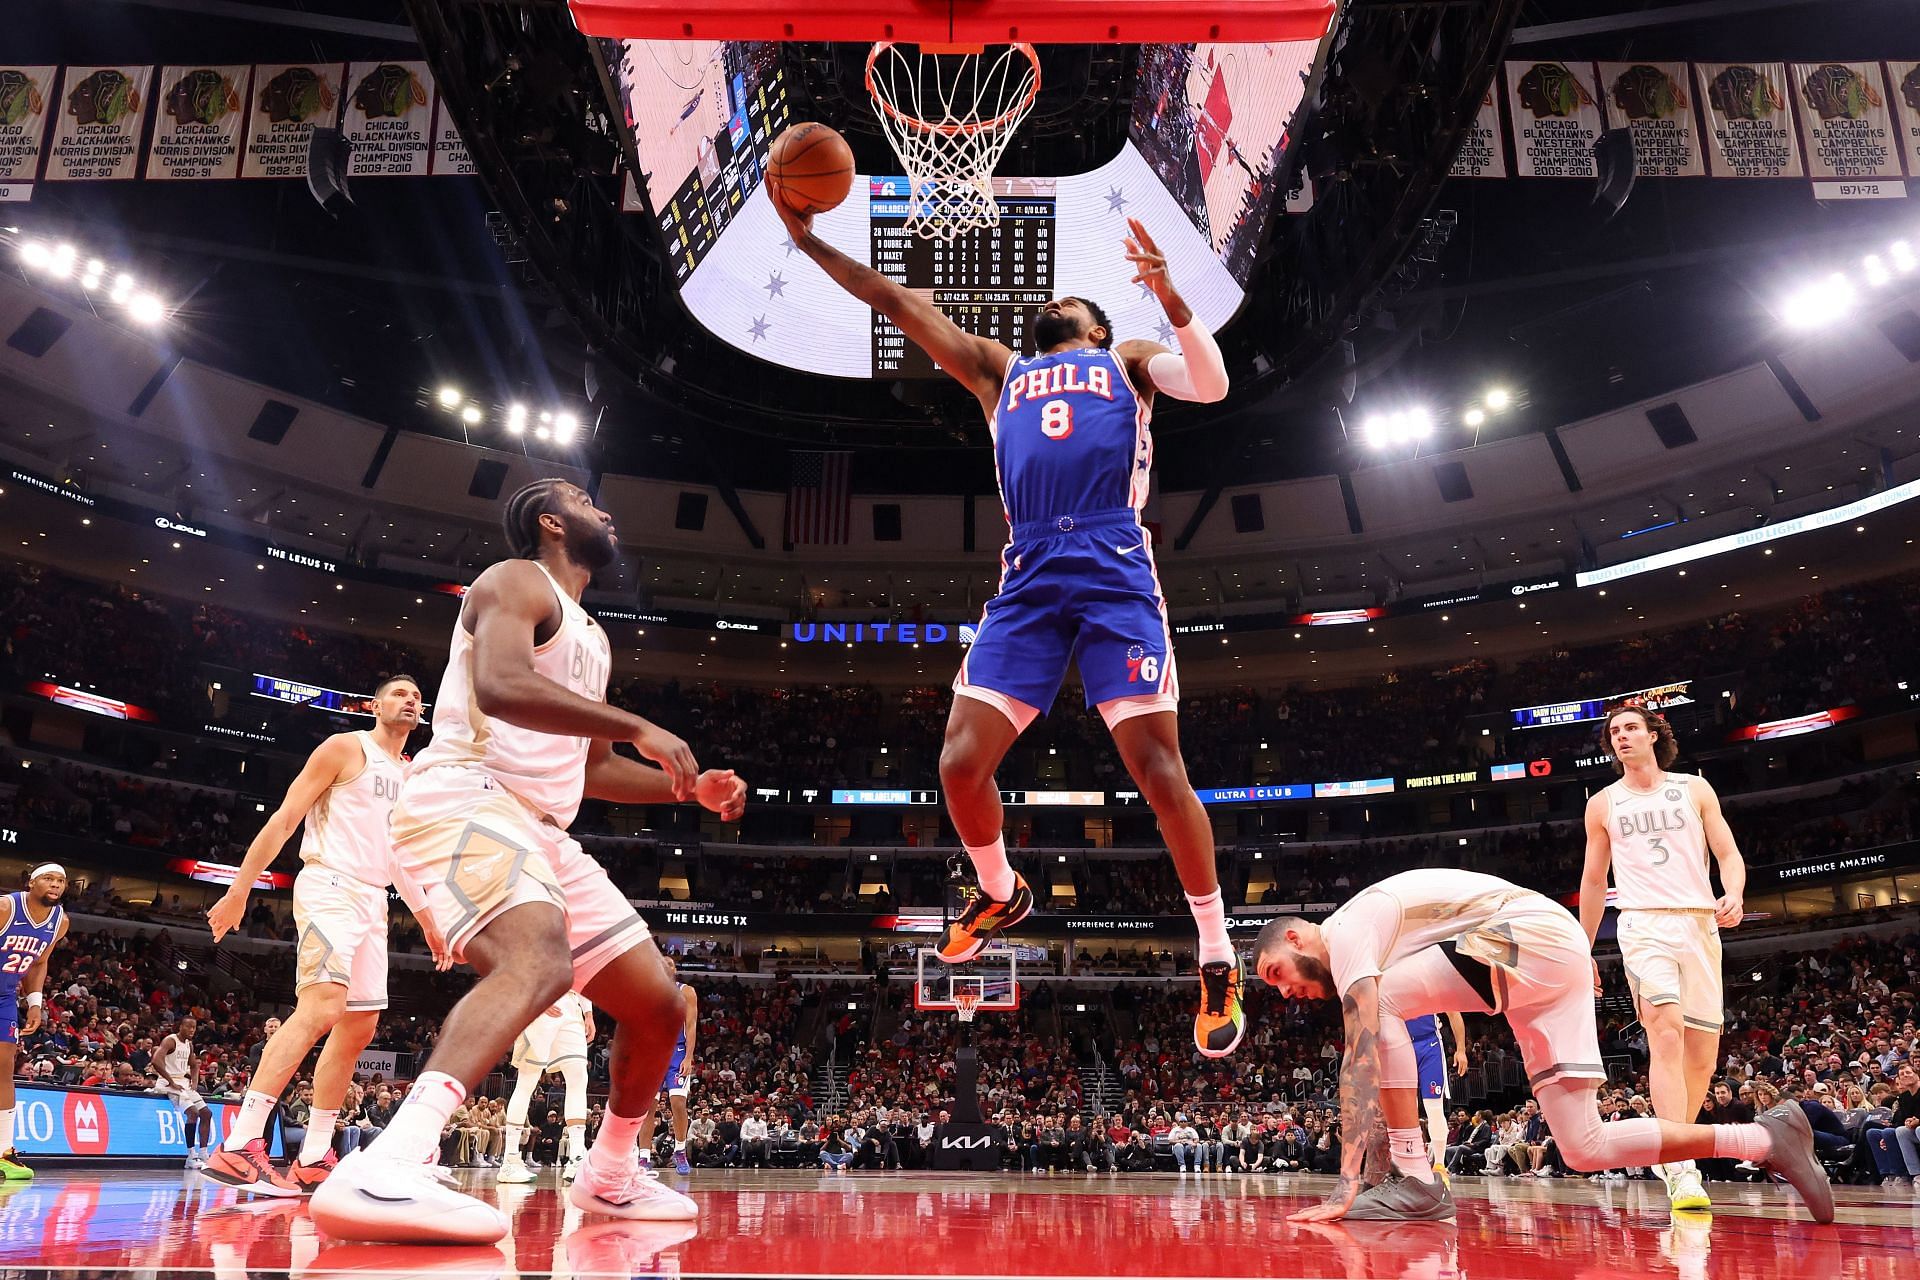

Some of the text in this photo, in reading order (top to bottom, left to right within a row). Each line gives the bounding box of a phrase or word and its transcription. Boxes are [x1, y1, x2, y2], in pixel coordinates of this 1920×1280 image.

[366, 122, 408, 130] CHICAGO
[1534, 121, 1578, 130] CHICAGO
[1631, 120, 1675, 129] CHICAGO
[1728, 121, 1772, 129] CHICAGO
[1824, 120, 1869, 129] CHICAGO
[77, 126, 120, 134] CHICAGO
[176, 126, 219, 134] CHICAGO
[1524, 130, 1594, 139] BLACKHAWKS
[1634, 129, 1689, 138] ACKHAWKS
[1716, 130, 1786, 139] BLACKHAWKS
[1813, 129, 1885, 138] BLACKHAWKS
[62, 136, 130, 145] BLACKHAWKS
[160, 136, 231, 144] BLACKHAWKS
[351, 132, 420, 141] BLACKHAWKS
[390, 142, 428, 151] DIVISION
[1534, 139, 1585, 148] WESTERN
[1635, 139, 1684, 147] AMPBELL
[1724, 139, 1782, 148] CAMPBELL
[1822, 139, 1880, 148] CAMPBELL
[53, 146, 134, 156] NORRIS DIVISION
[154, 146, 235, 156] NORRIS DIVISION
[249, 144, 286, 154] NORRIS
[1527, 148, 1595, 158] CONFERENCE
[1636, 148, 1691, 156] NFERENCE
[1720, 148, 1790, 157] CONFERENCE
[1818, 147, 1888, 157] CONFERENCE
[62, 158, 121, 166] CHAMPIONS
[163, 157, 222, 166] CHAMPIONS
[354, 153, 412, 162] CHAMPIONS
[1533, 158, 1592, 166] CHAMPIONS
[1728, 158, 1786, 166] CHAMPIONS
[1824, 157, 1884, 166] CHAMPIONS
[68, 168, 112, 177] 1989-90
[171, 168, 210, 177] 1990-91
[353, 164, 412, 173] 2009-2010
[1534, 167, 1592, 176] 2009-2010
[1640, 167, 1678, 175] 1991-92
[1736, 167, 1780, 176] 1972-73
[1835, 167, 1876, 176] 1970-71
[1006, 180, 1012, 194] 7
[1840, 186, 1879, 194] 1971-72
[935, 240, 942, 248] 03
[884, 252, 903, 260] MAXEY
[935, 252, 942, 260] 03
[884, 264, 906, 272] GEORGE
[935, 264, 942, 272] 03
[935, 276, 942, 284] 03
[974, 315, 978, 324] 2
[874, 327, 882, 335] 44
[884, 338, 904, 346] GIDDEY
[884, 350, 904, 358] LAVINE
[878, 361, 898, 369] 2 BALL
[1007, 363, 1114, 413] PHILA
[1041, 400, 1074, 440] 8
[12, 472, 94, 506] EXPERIENCE AMAZING
[265, 547, 334, 572] THE LEXUS TX
[1424, 595, 1480, 608] EXPERIENCE AMAZING
[598, 611, 636, 620] EXPERIENCE
[794, 623, 946, 642] UNITED
[1126, 656, 1159, 684] 76
[205, 725, 276, 743] EXPERIENCE AMAZING
[1575, 758, 1591, 767] THE
[1407, 772, 1477, 788] POINTS IN THE PAINT
[1010, 793, 1016, 802] 7
[1215, 789, 1291, 799] ULTRA CLUB
[1619, 808, 1685, 837] BULLS
[2, 829, 17, 843] TX
[1648, 838, 1670, 865] 3
[1780, 854, 1885, 878] EXPERIENCE AMAZING
[667, 913, 747, 926] THE LEXUS TX
[1, 935, 47, 956] PHILA
[2, 954, 34, 973] 28
